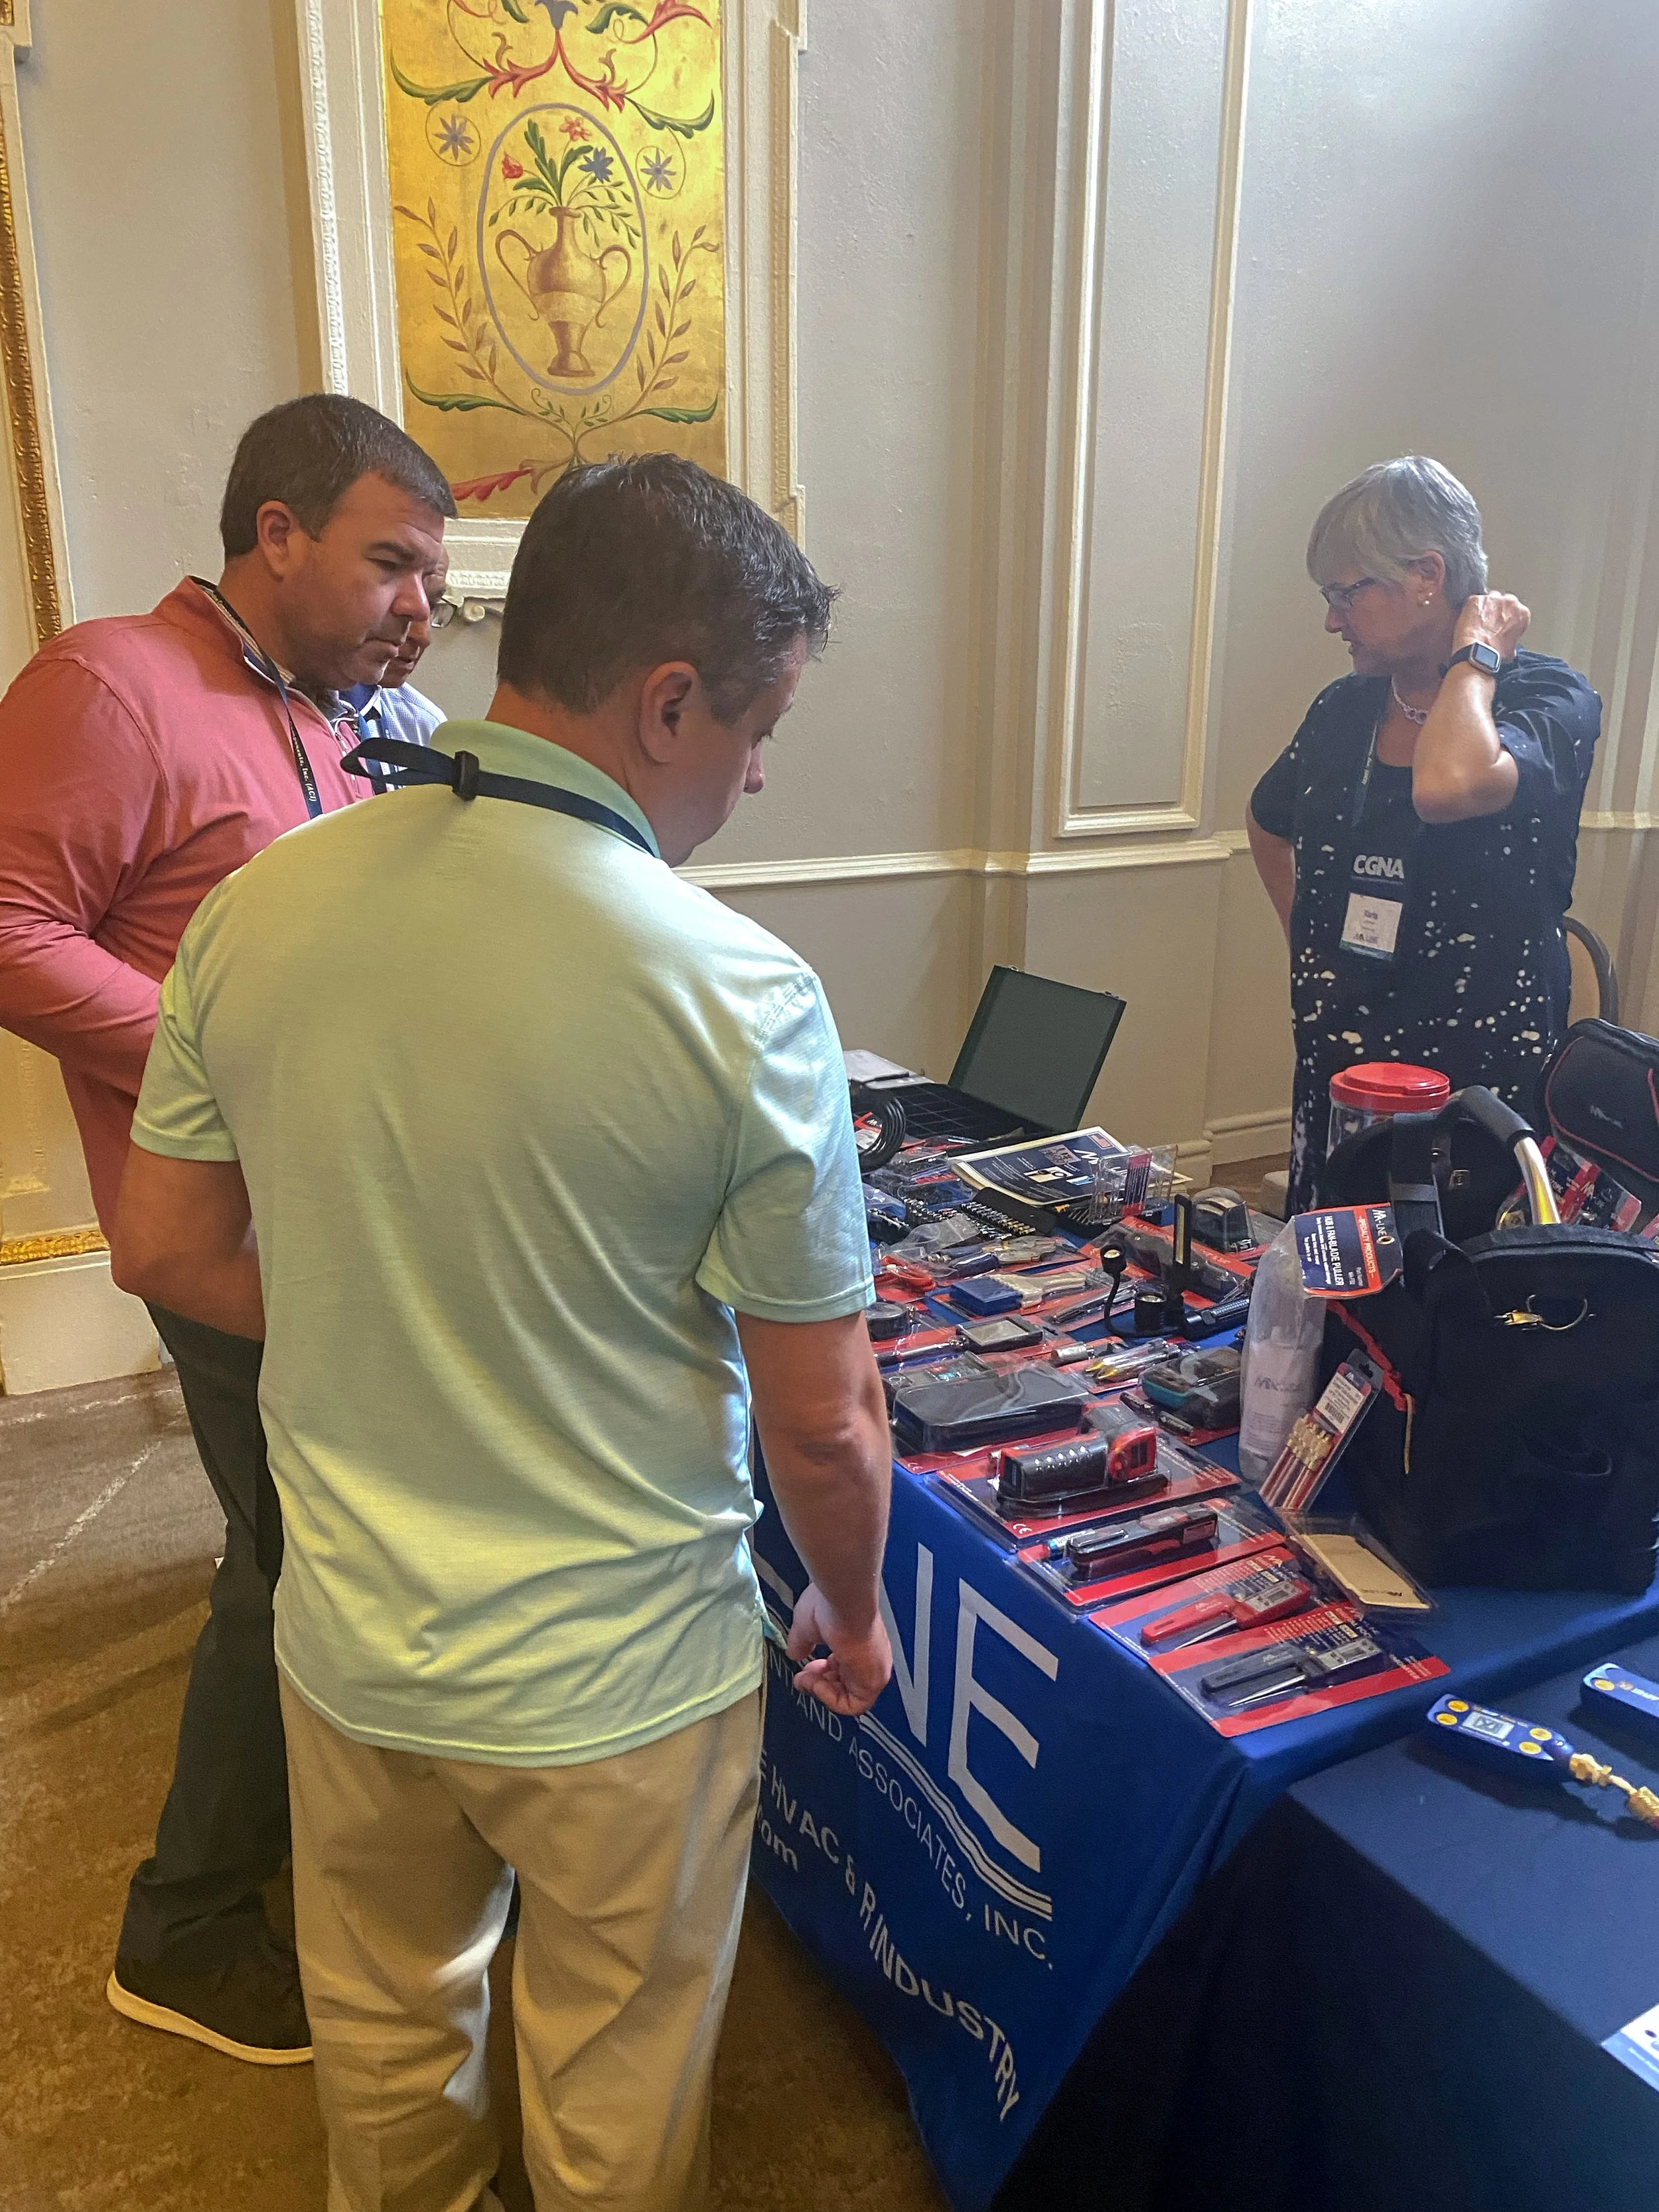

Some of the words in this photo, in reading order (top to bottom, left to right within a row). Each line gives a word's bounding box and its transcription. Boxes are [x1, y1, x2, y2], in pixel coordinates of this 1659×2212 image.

[305, 782, 317, 802] (ACI)
[1353, 854, 1405, 879] CGNA
[1332, 1262, 1344, 1286] PULLER
[796, 1692, 843, 1742] AND
[984, 1903, 1053, 1970] INC.
